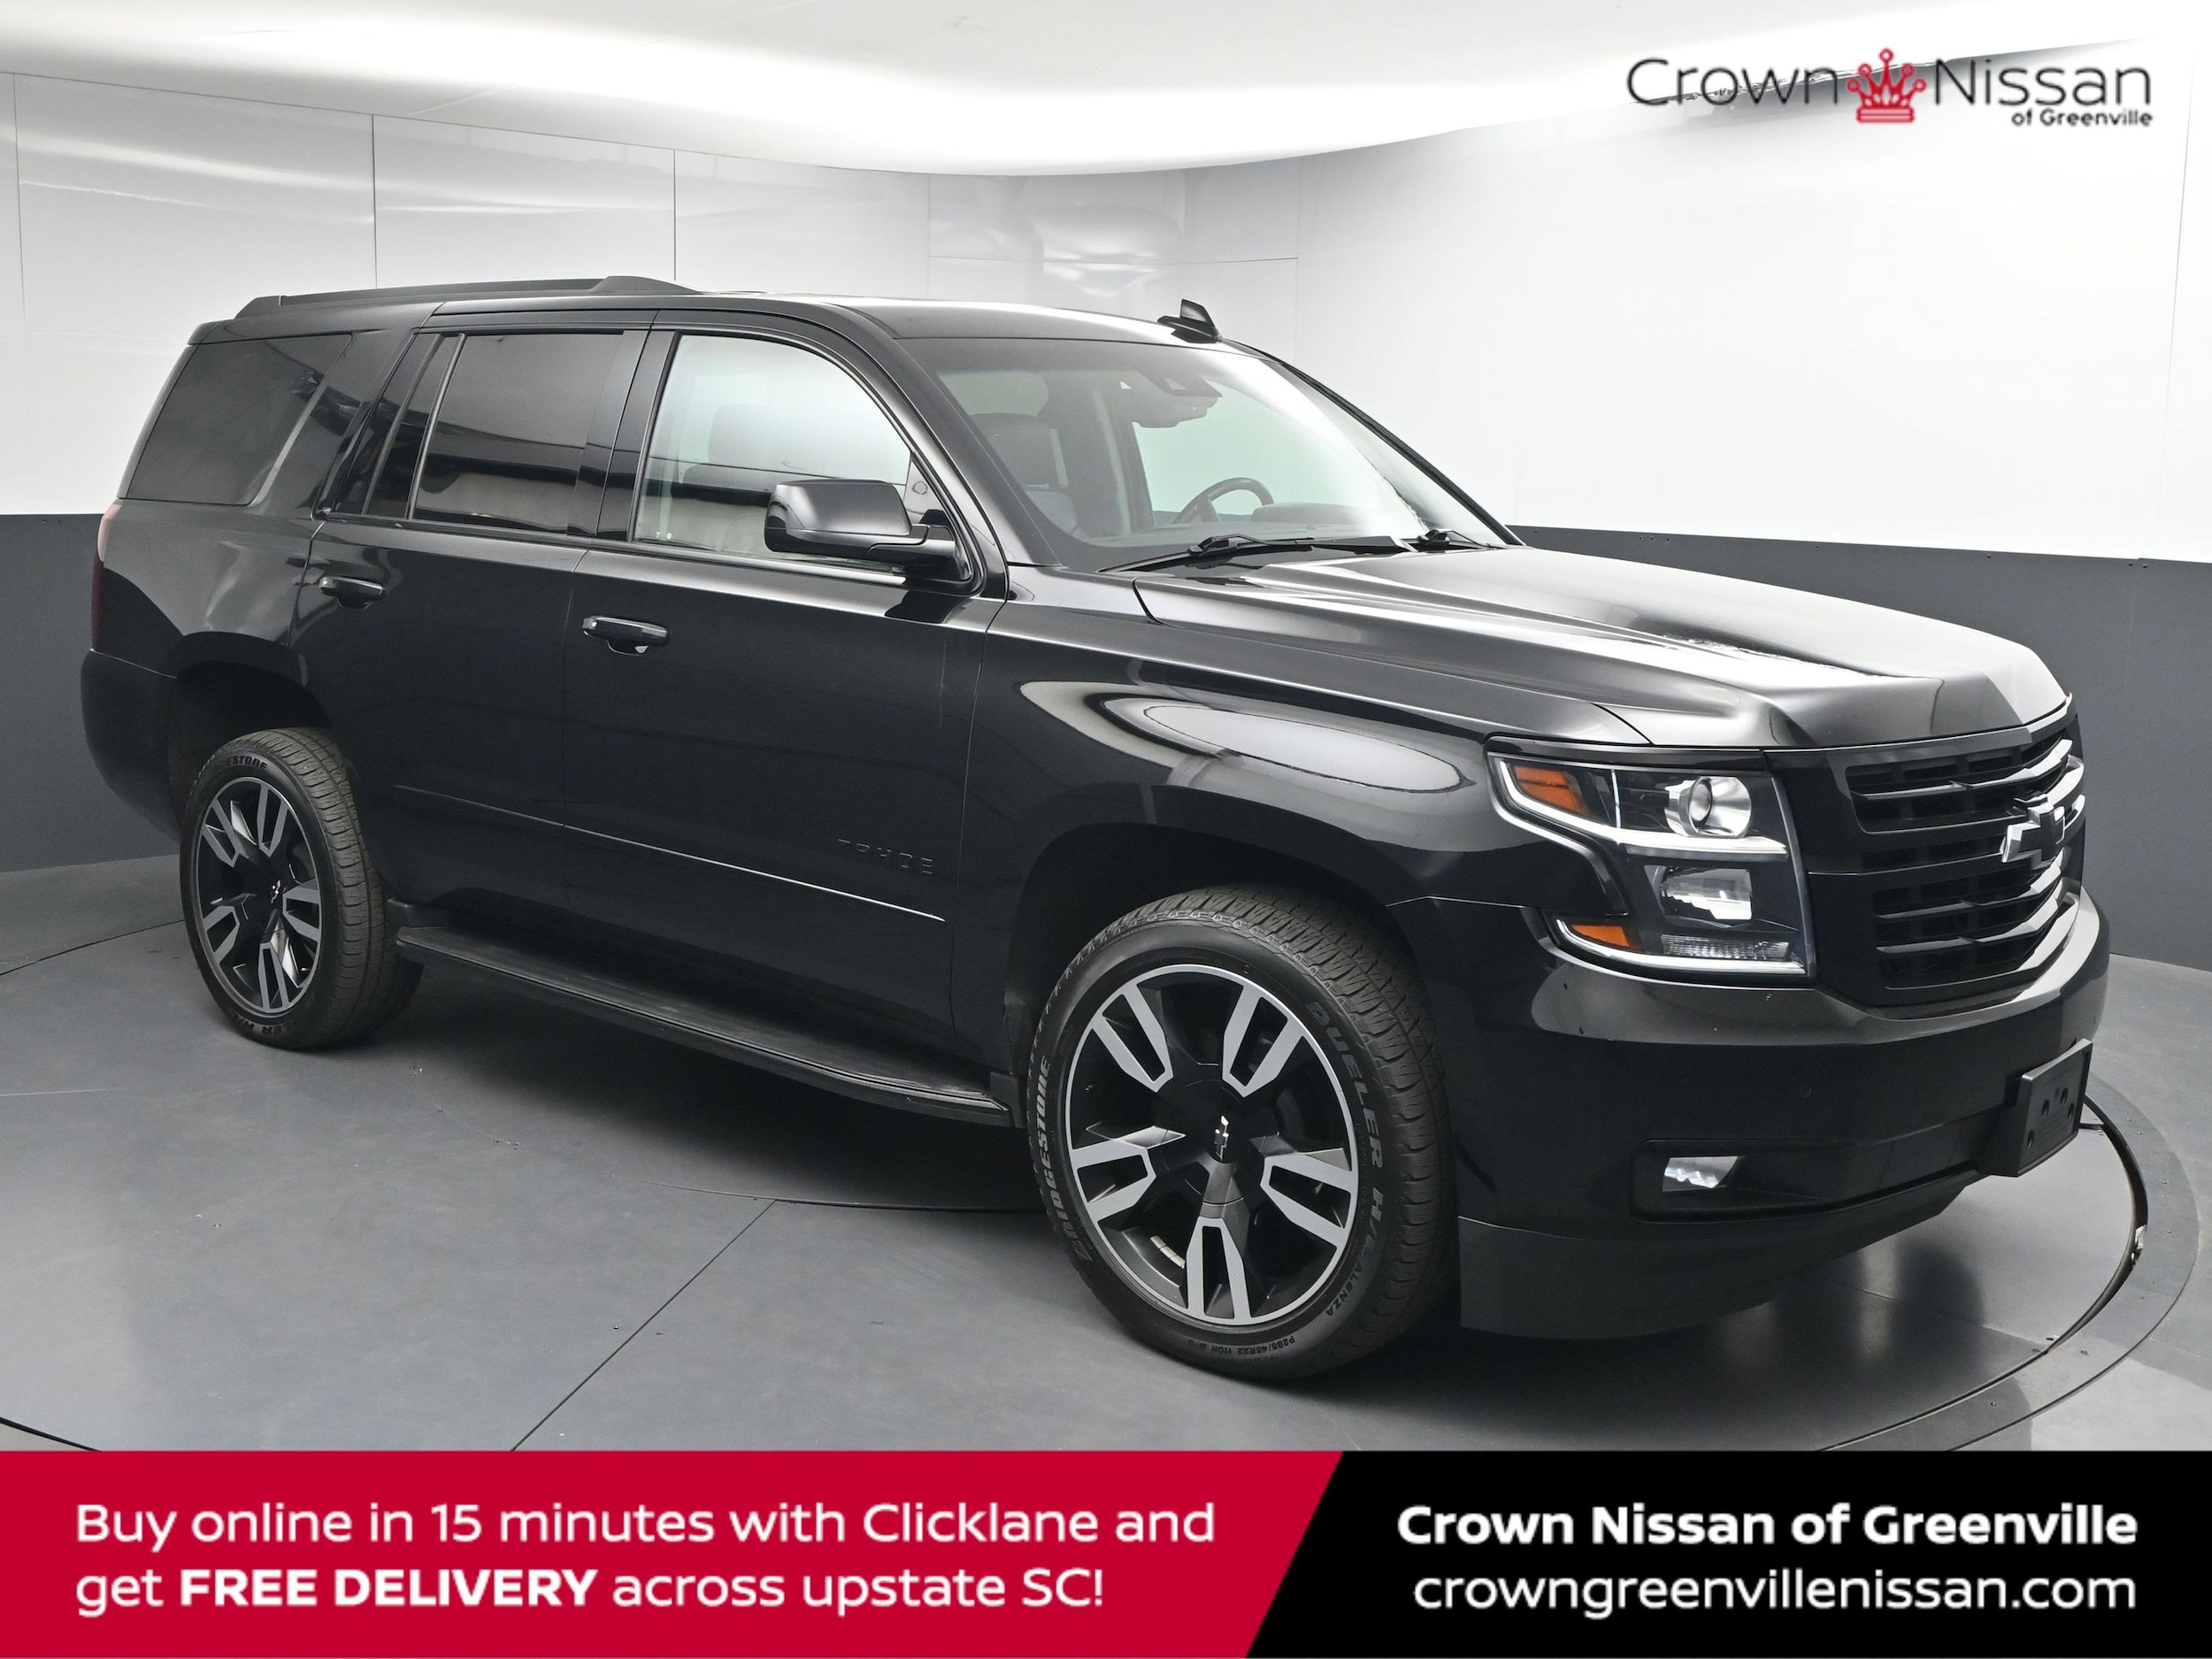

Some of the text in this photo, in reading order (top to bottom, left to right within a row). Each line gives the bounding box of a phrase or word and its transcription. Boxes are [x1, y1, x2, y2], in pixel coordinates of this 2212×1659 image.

[1036, 1055, 1094, 1262] BRIDGESTONE
[1306, 1001, 1383, 1168] DUELER
[1325, 1261, 1363, 1316] ALENZA
